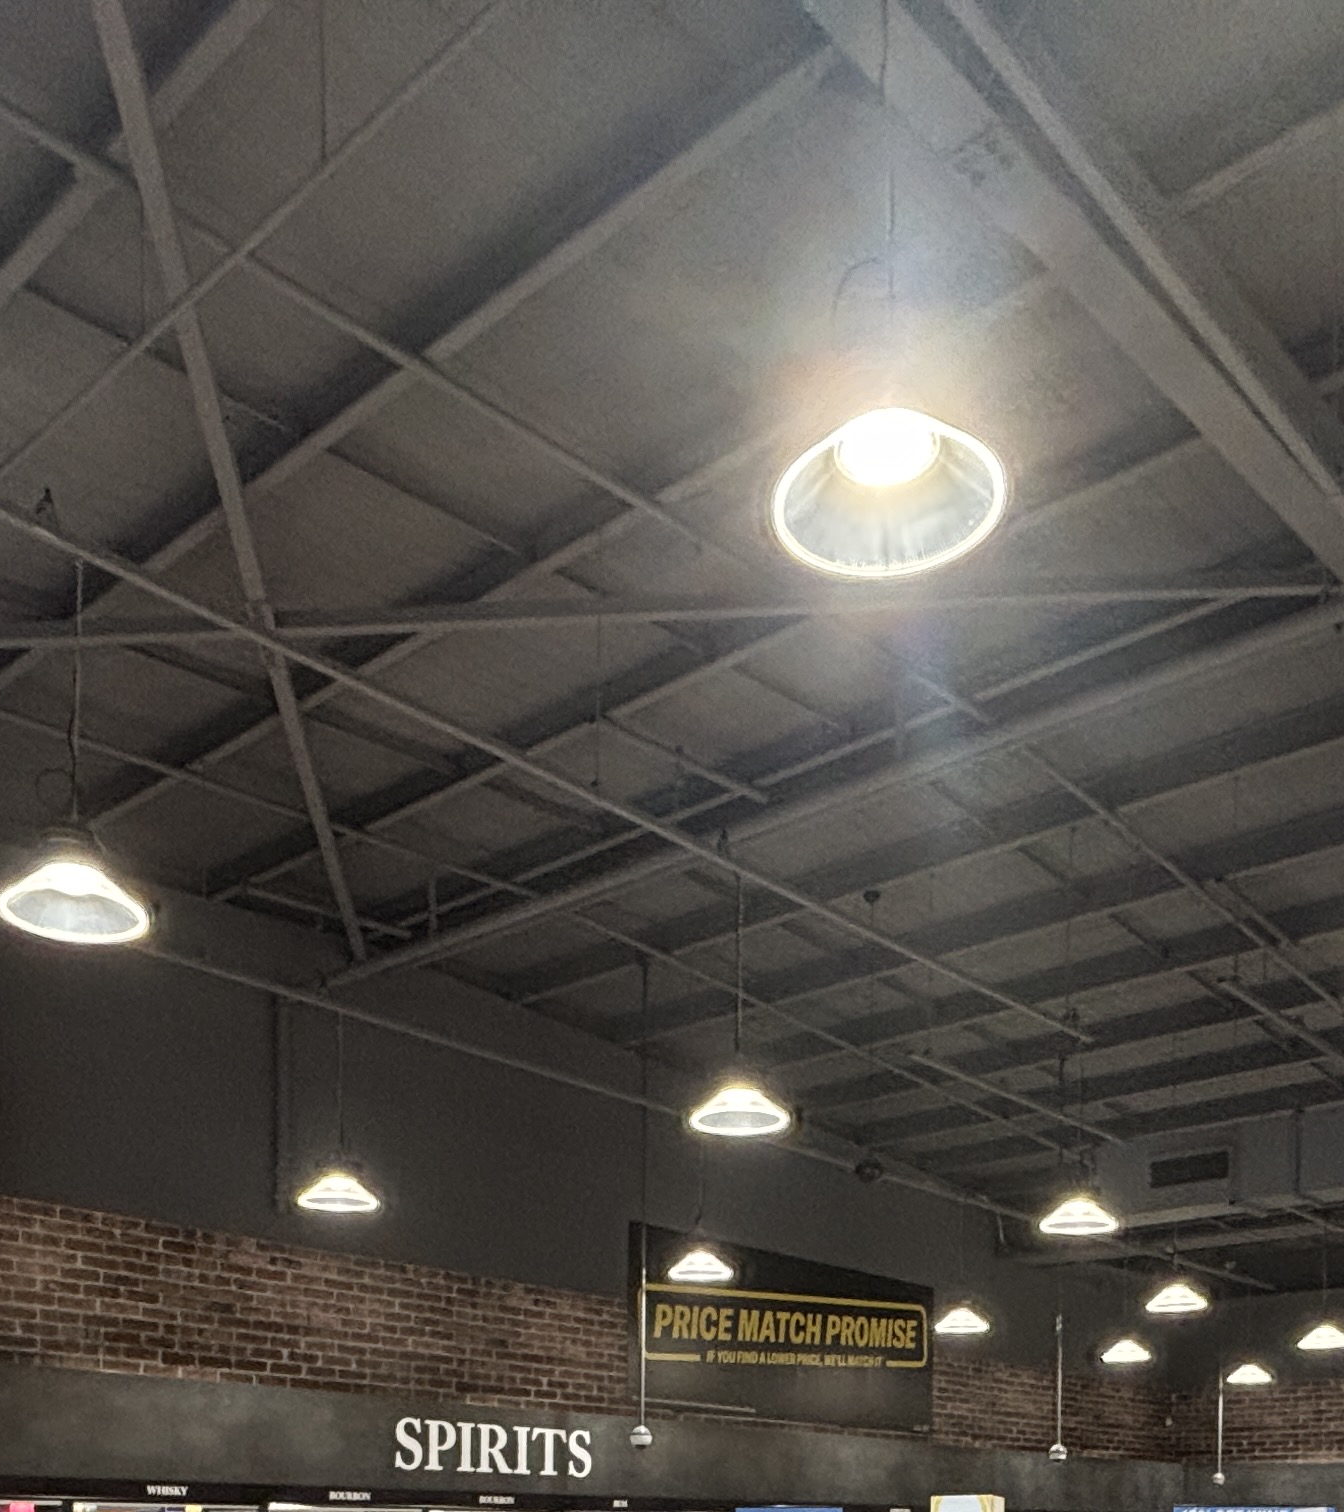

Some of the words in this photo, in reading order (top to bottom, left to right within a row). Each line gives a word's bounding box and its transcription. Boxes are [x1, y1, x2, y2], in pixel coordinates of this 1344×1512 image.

[654, 1303, 734, 1341] PRICE
[738, 1307, 822, 1346] MATCH
[825, 1314, 918, 1350] PROMISE
[395, 1417, 593, 1478] SPIRITS
[147, 1485, 188, 1497] WHISKY
